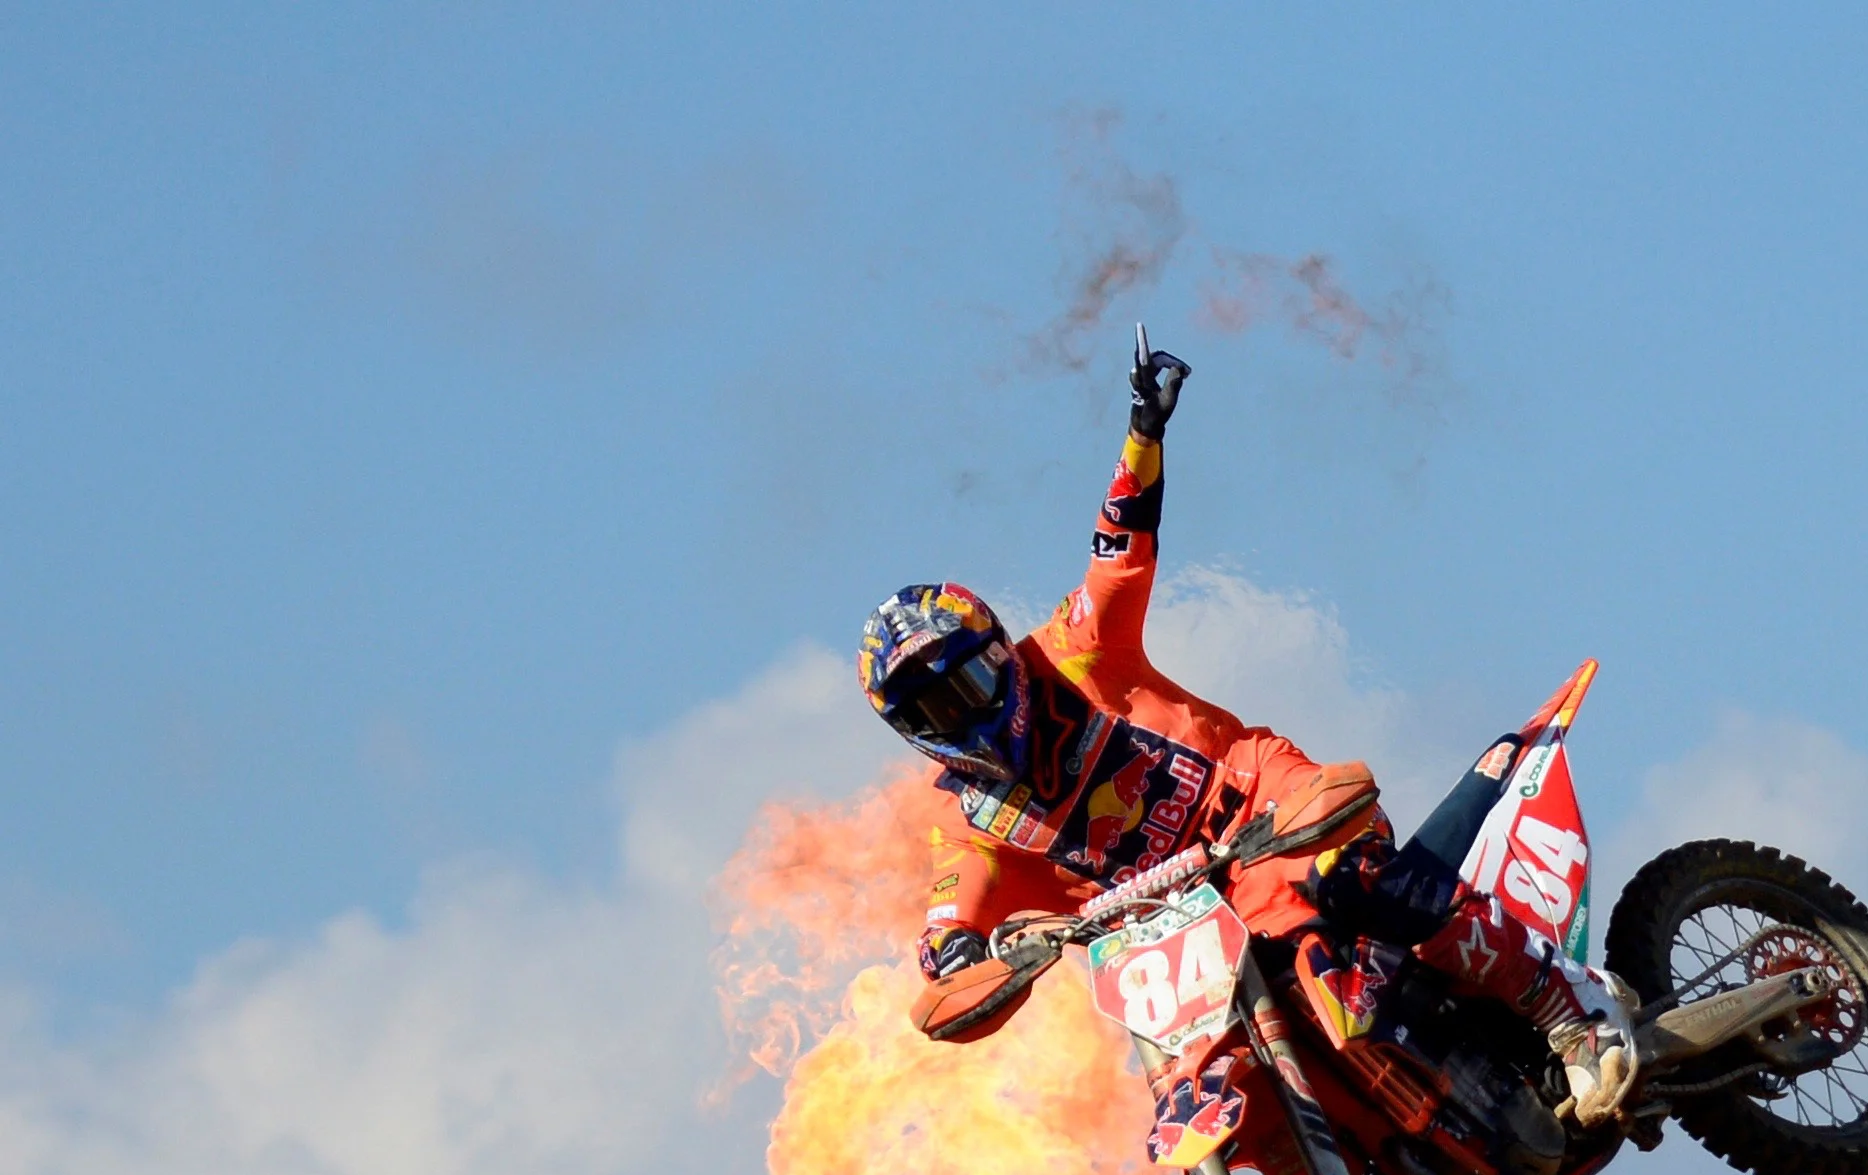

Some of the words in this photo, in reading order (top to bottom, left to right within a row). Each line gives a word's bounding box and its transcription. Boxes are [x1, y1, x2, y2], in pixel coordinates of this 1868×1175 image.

[1149, 752, 1208, 833] Bull
[1504, 816, 1587, 925] 84
[1118, 919, 1235, 1034] 84
